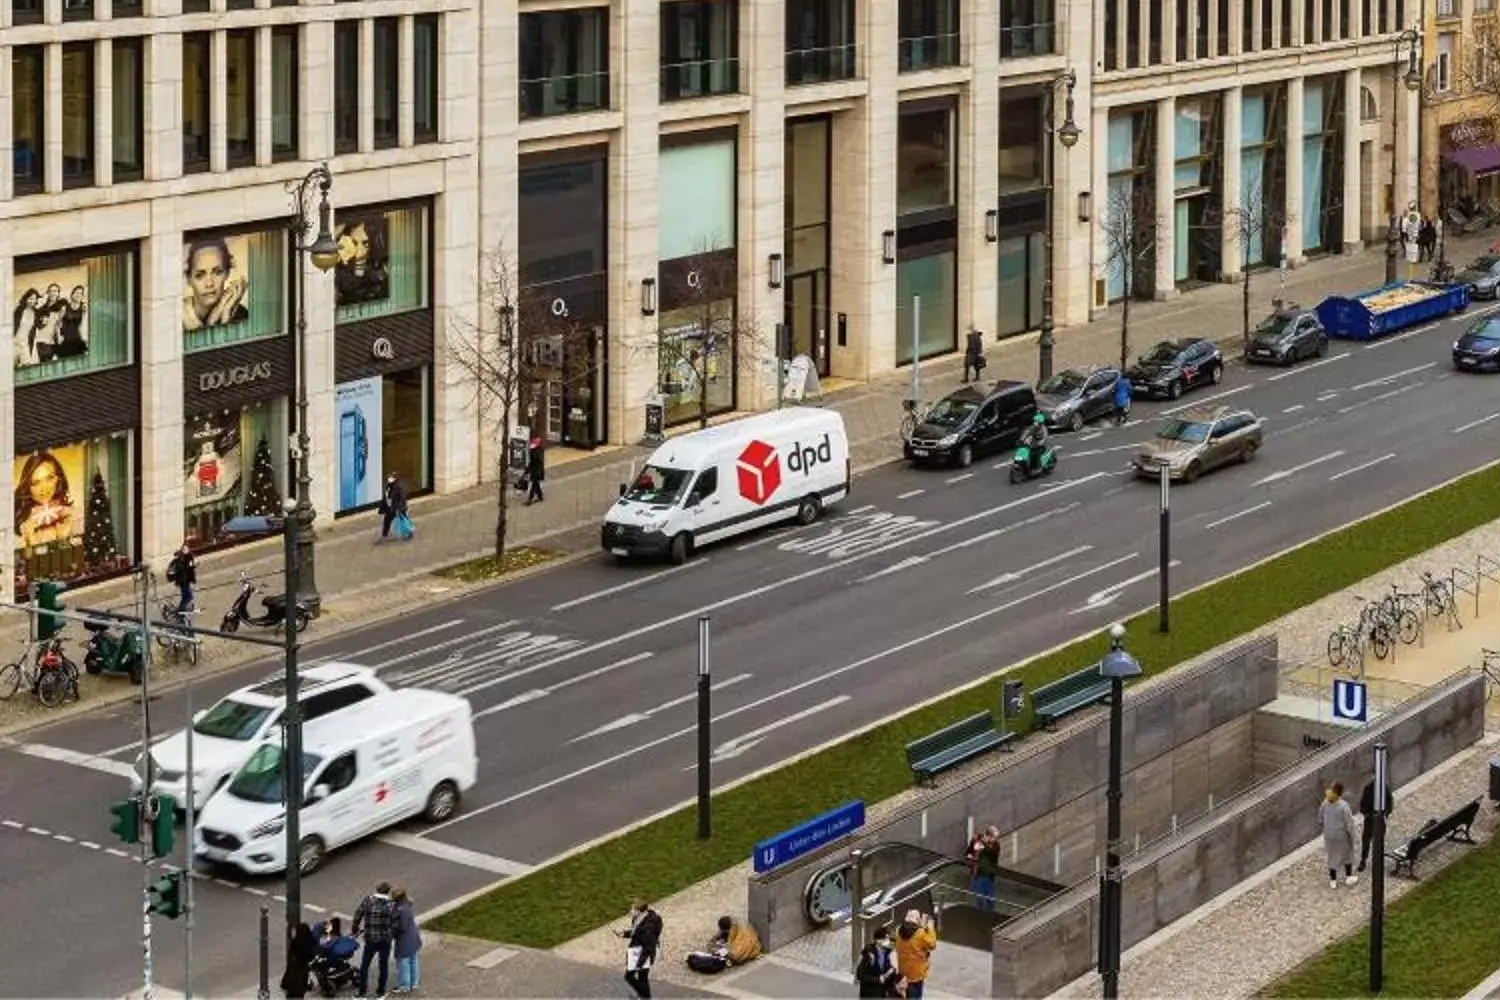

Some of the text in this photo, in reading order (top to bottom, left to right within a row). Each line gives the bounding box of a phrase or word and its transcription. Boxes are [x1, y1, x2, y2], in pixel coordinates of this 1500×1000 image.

[201, 362, 271, 391] DOUGLAS
[787, 433, 831, 476] dpd
[1338, 682, 1362, 717] U
[763, 847, 776, 865] U
